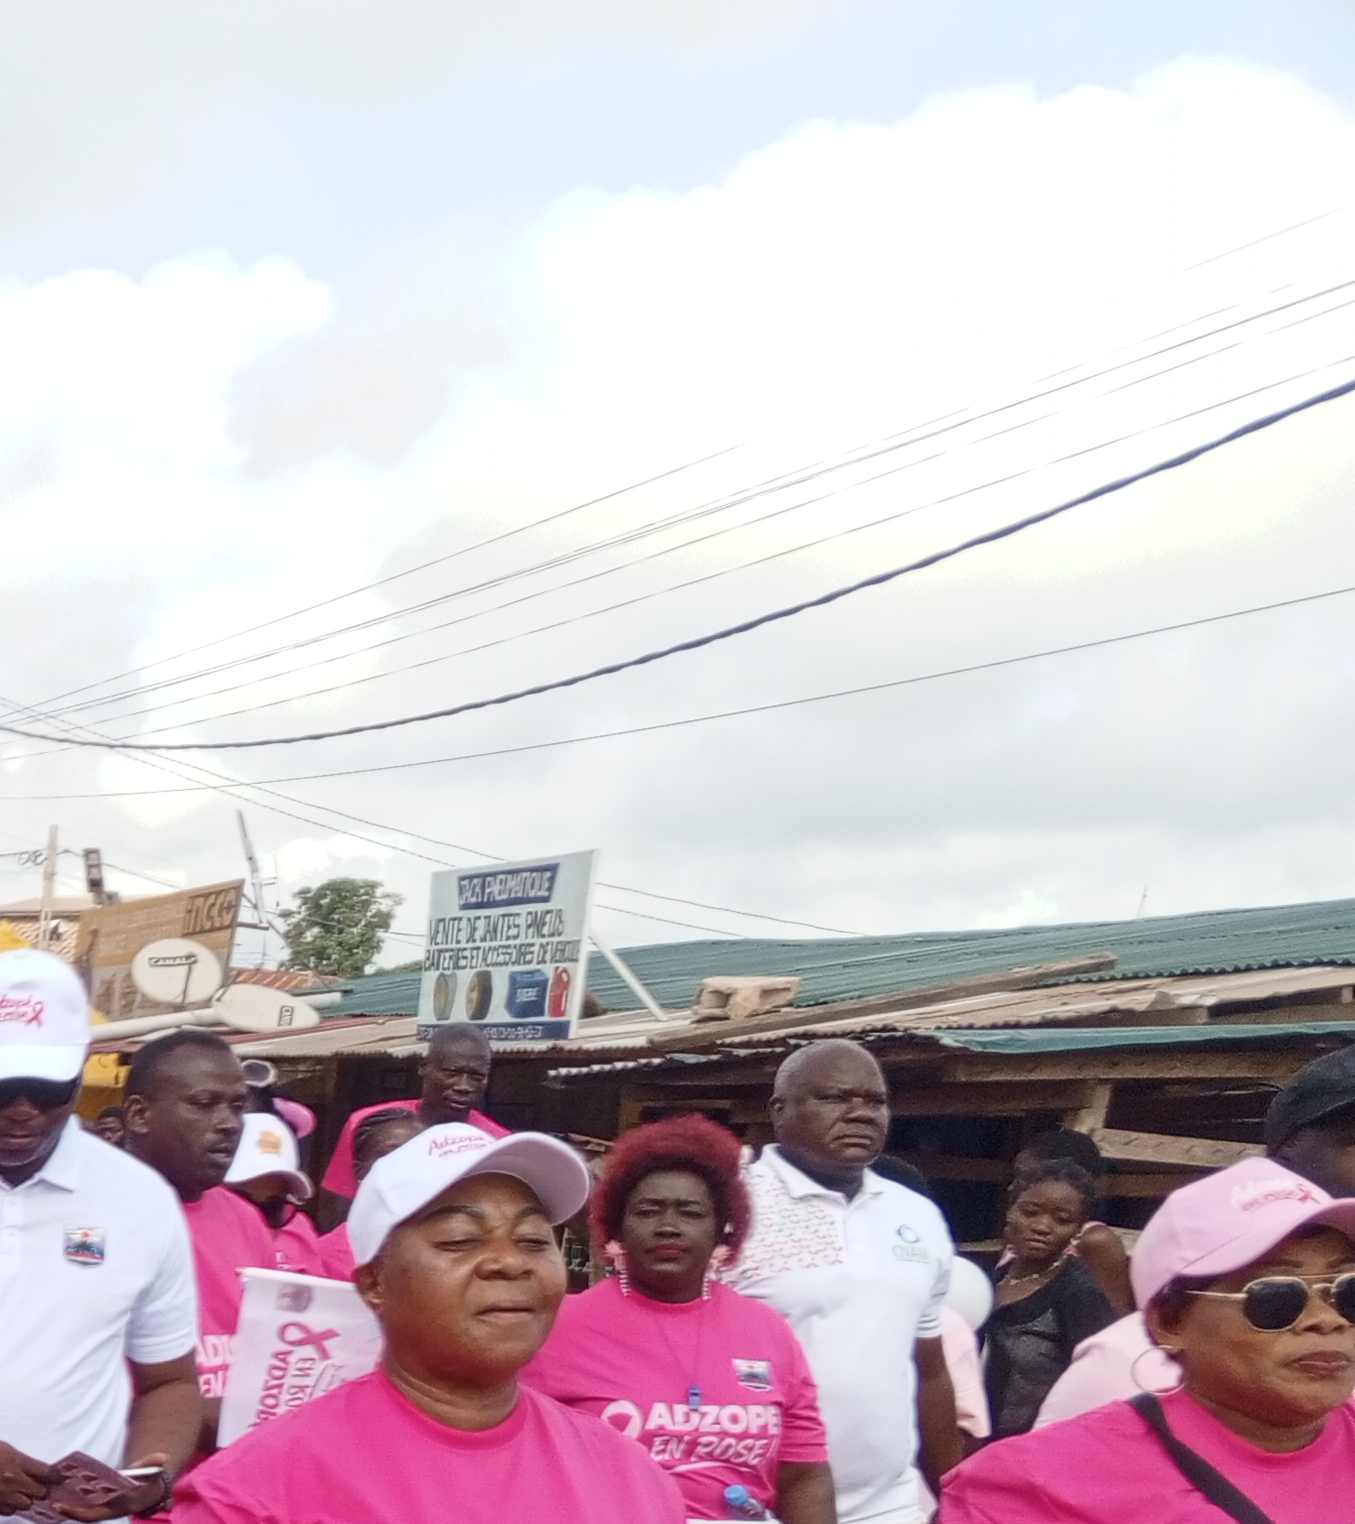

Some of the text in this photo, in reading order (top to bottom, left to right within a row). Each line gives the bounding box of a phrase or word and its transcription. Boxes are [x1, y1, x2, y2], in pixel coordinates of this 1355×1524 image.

[430, 909, 564, 946] VENTE DE JANTES PNEUS
